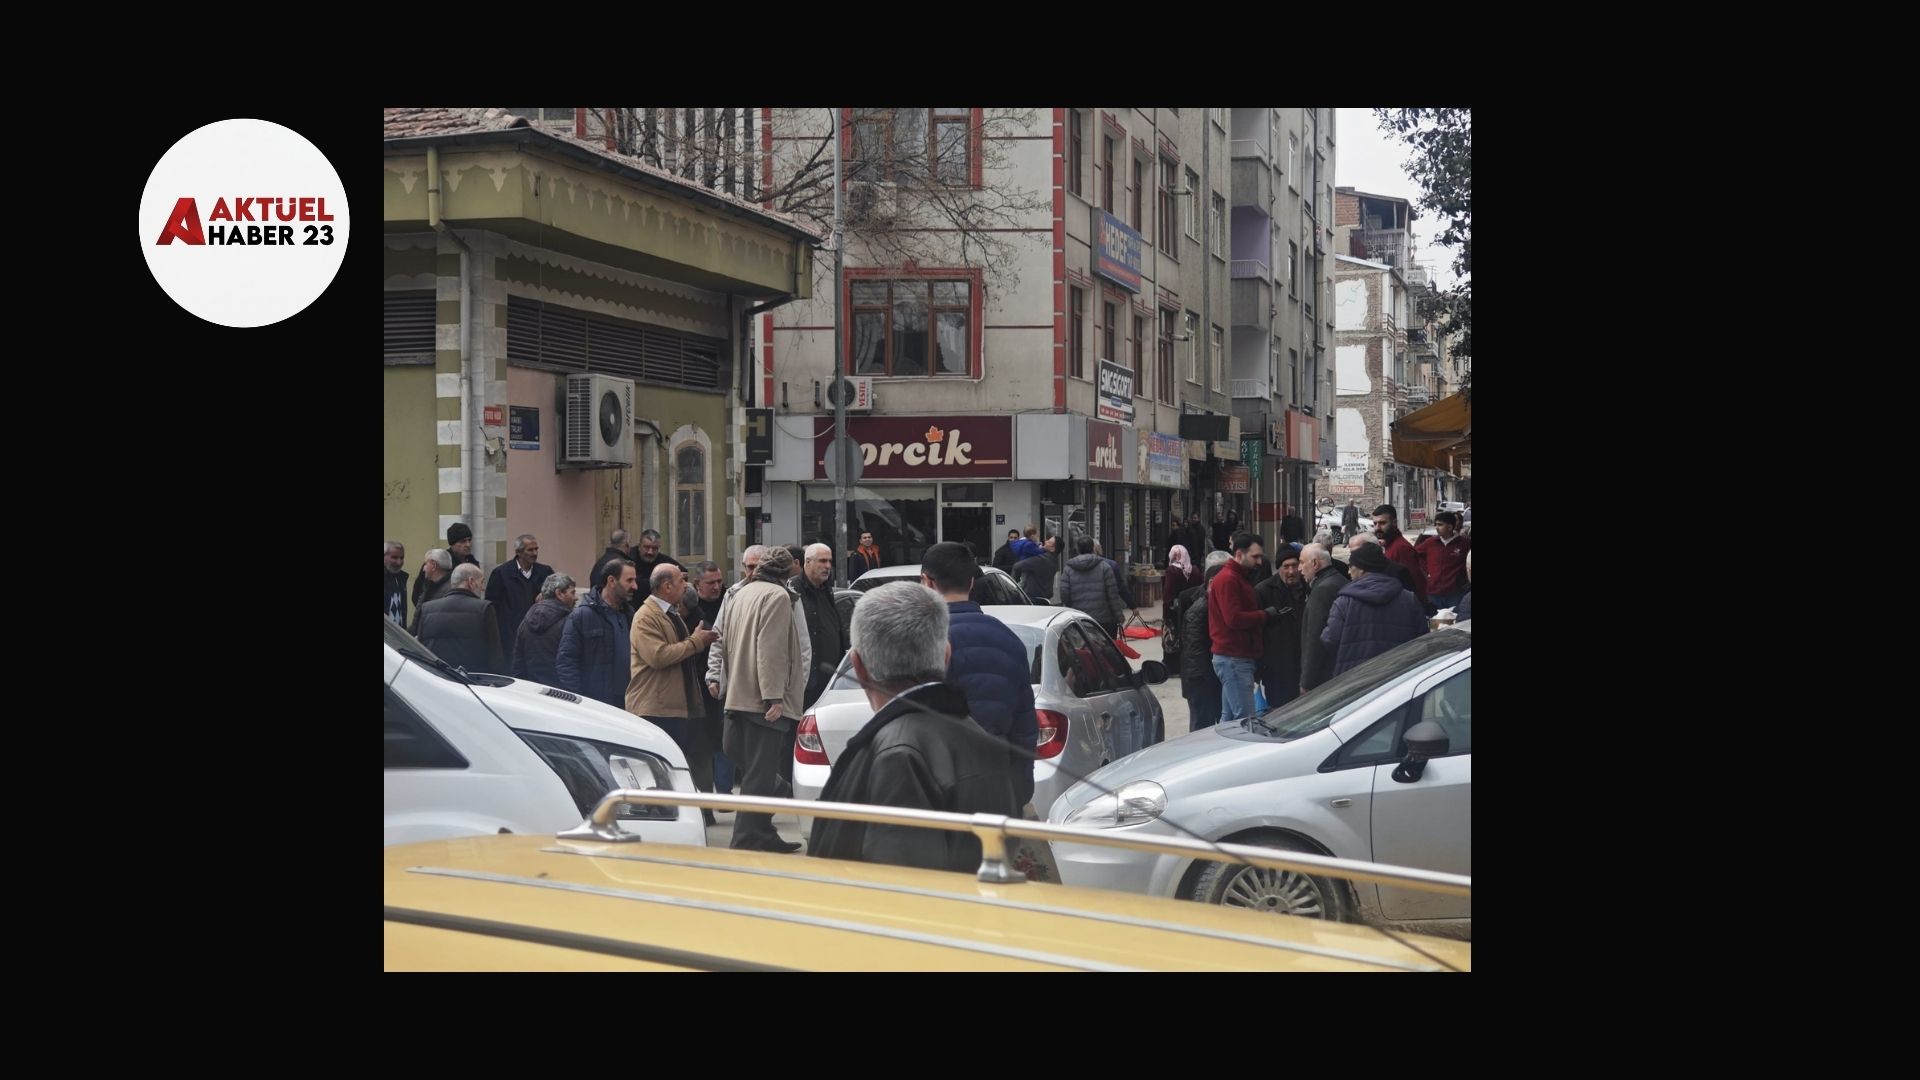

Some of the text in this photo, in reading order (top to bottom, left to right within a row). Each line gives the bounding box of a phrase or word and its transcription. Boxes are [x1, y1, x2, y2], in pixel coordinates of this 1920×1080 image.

[1105, 222, 1128, 264] HEDEF
[858, 381, 866, 407] VESTEL
[860, 425, 972, 466] orcik
[1095, 432, 1117, 469] orcik
